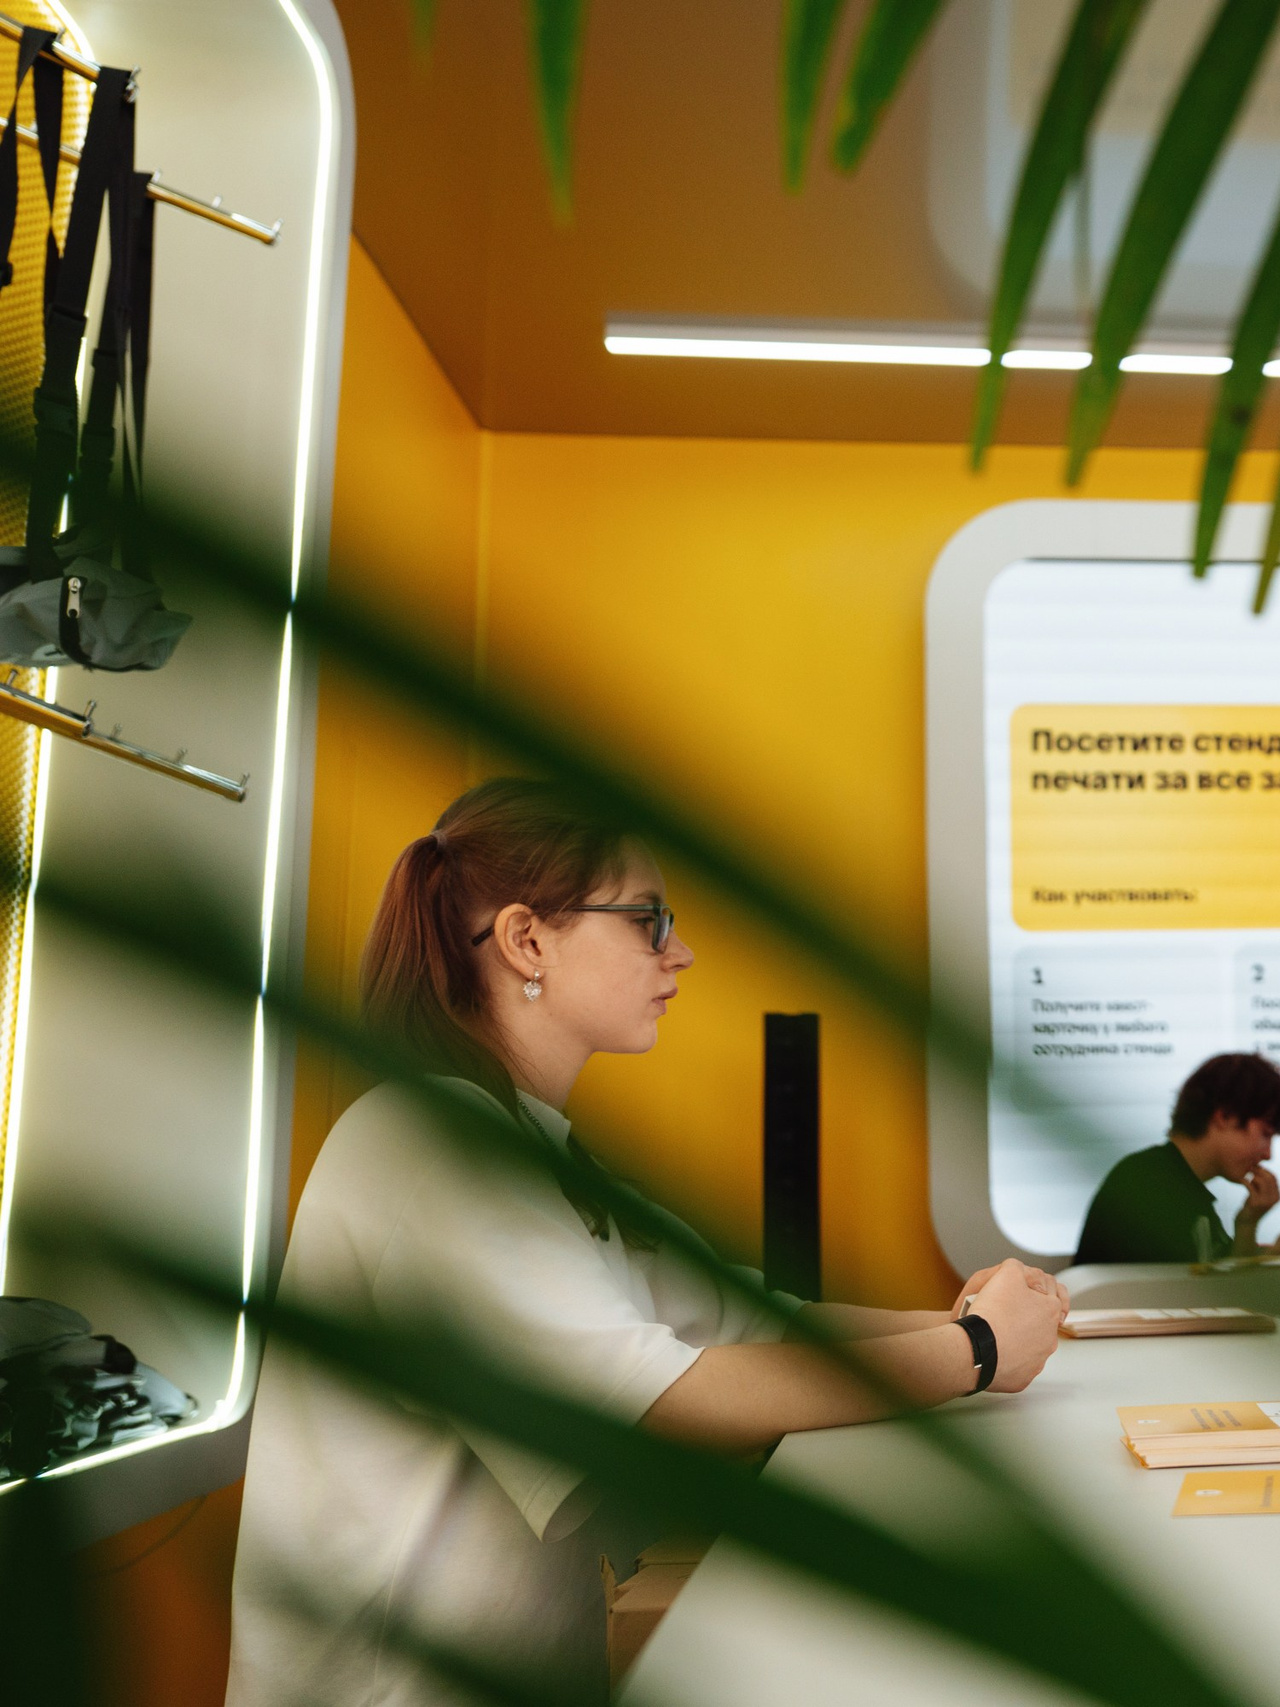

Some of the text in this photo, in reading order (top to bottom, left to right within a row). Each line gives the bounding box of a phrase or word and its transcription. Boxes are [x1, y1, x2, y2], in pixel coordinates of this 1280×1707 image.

[1031, 729, 1185, 754] Посетите
[1031, 771, 1146, 793] печати
[1154, 771, 1188, 792] за
[1198, 770, 1252, 792] все
[1032, 887, 1066, 903] Как
[1032, 966, 1044, 985] 1
[1252, 964, 1265, 982] 2
